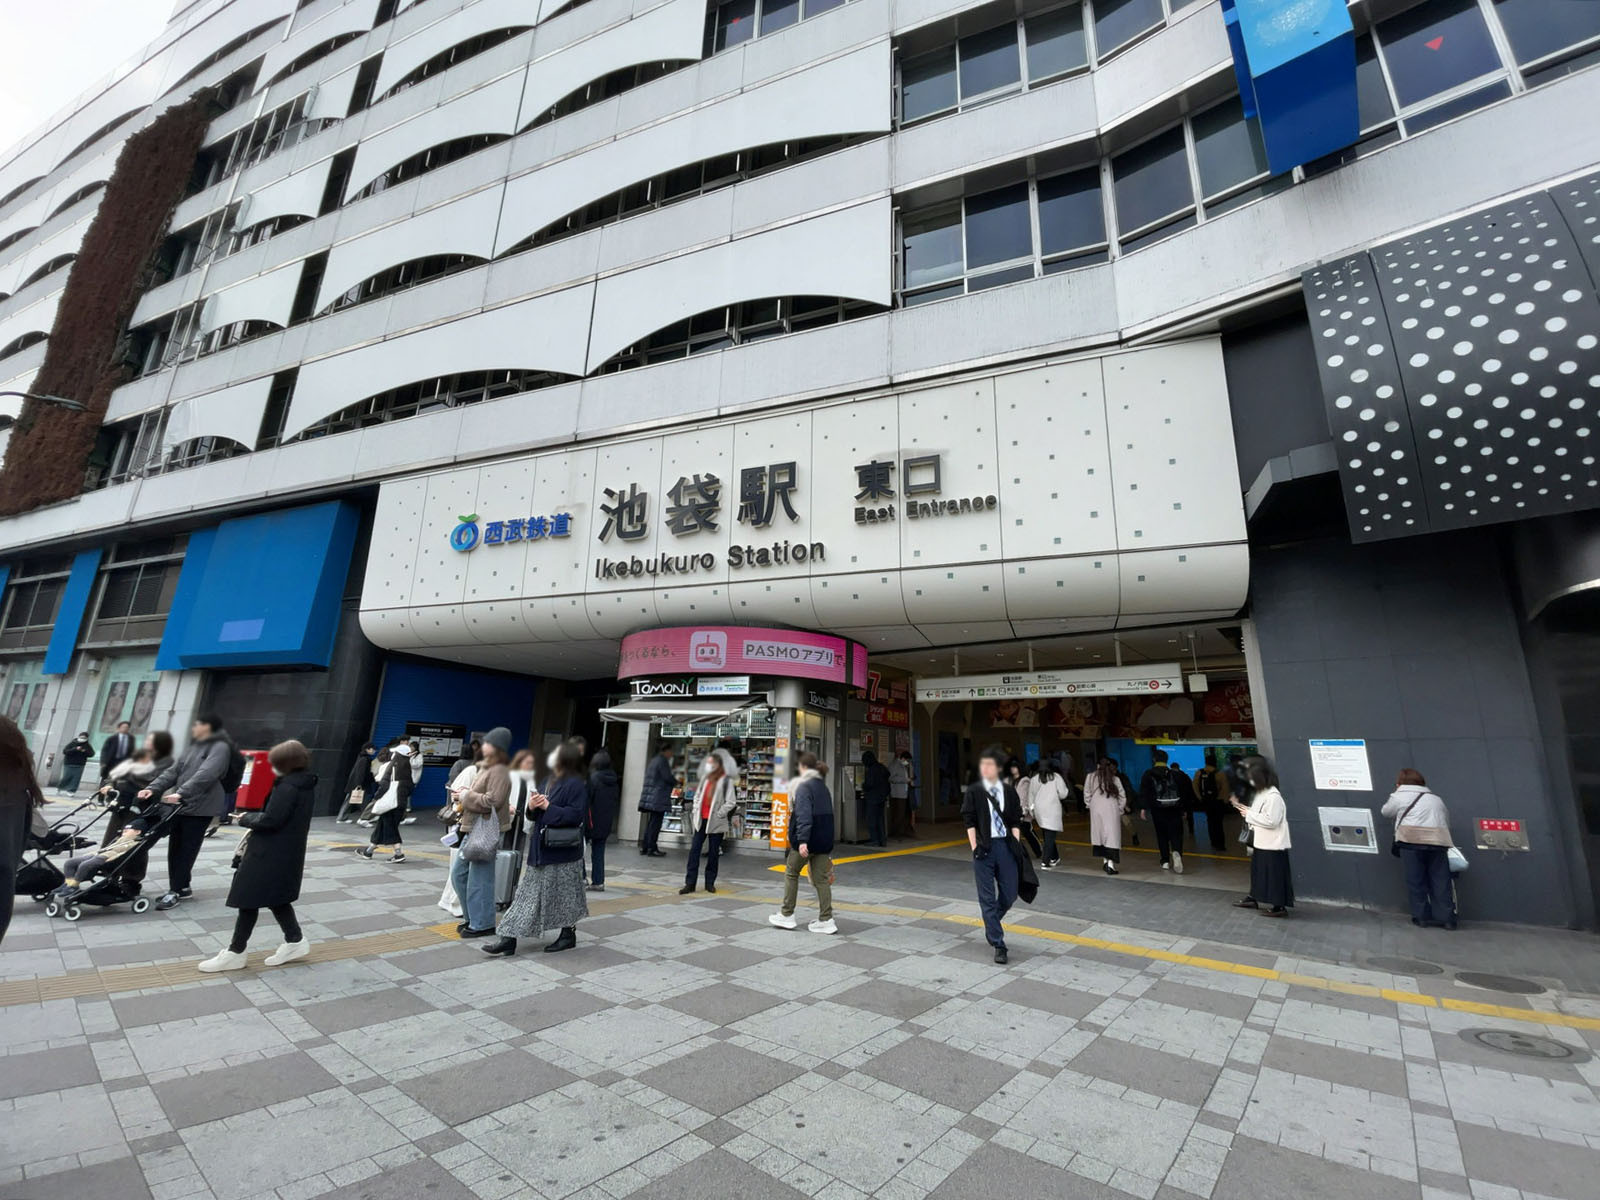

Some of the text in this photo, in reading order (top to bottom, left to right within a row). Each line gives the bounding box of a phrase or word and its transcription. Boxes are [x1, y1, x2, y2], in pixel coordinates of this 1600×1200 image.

[854, 454, 942, 502] 東口
[598, 461, 800, 543] 池袋駅
[854, 494, 998, 524] East Entrance
[483, 512, 573, 546] 西武鉄道
[595, 539, 826, 579] Ikebukuro Station
[868, 671, 881, 701] 7
[771, 799, 787, 842] たばこ
